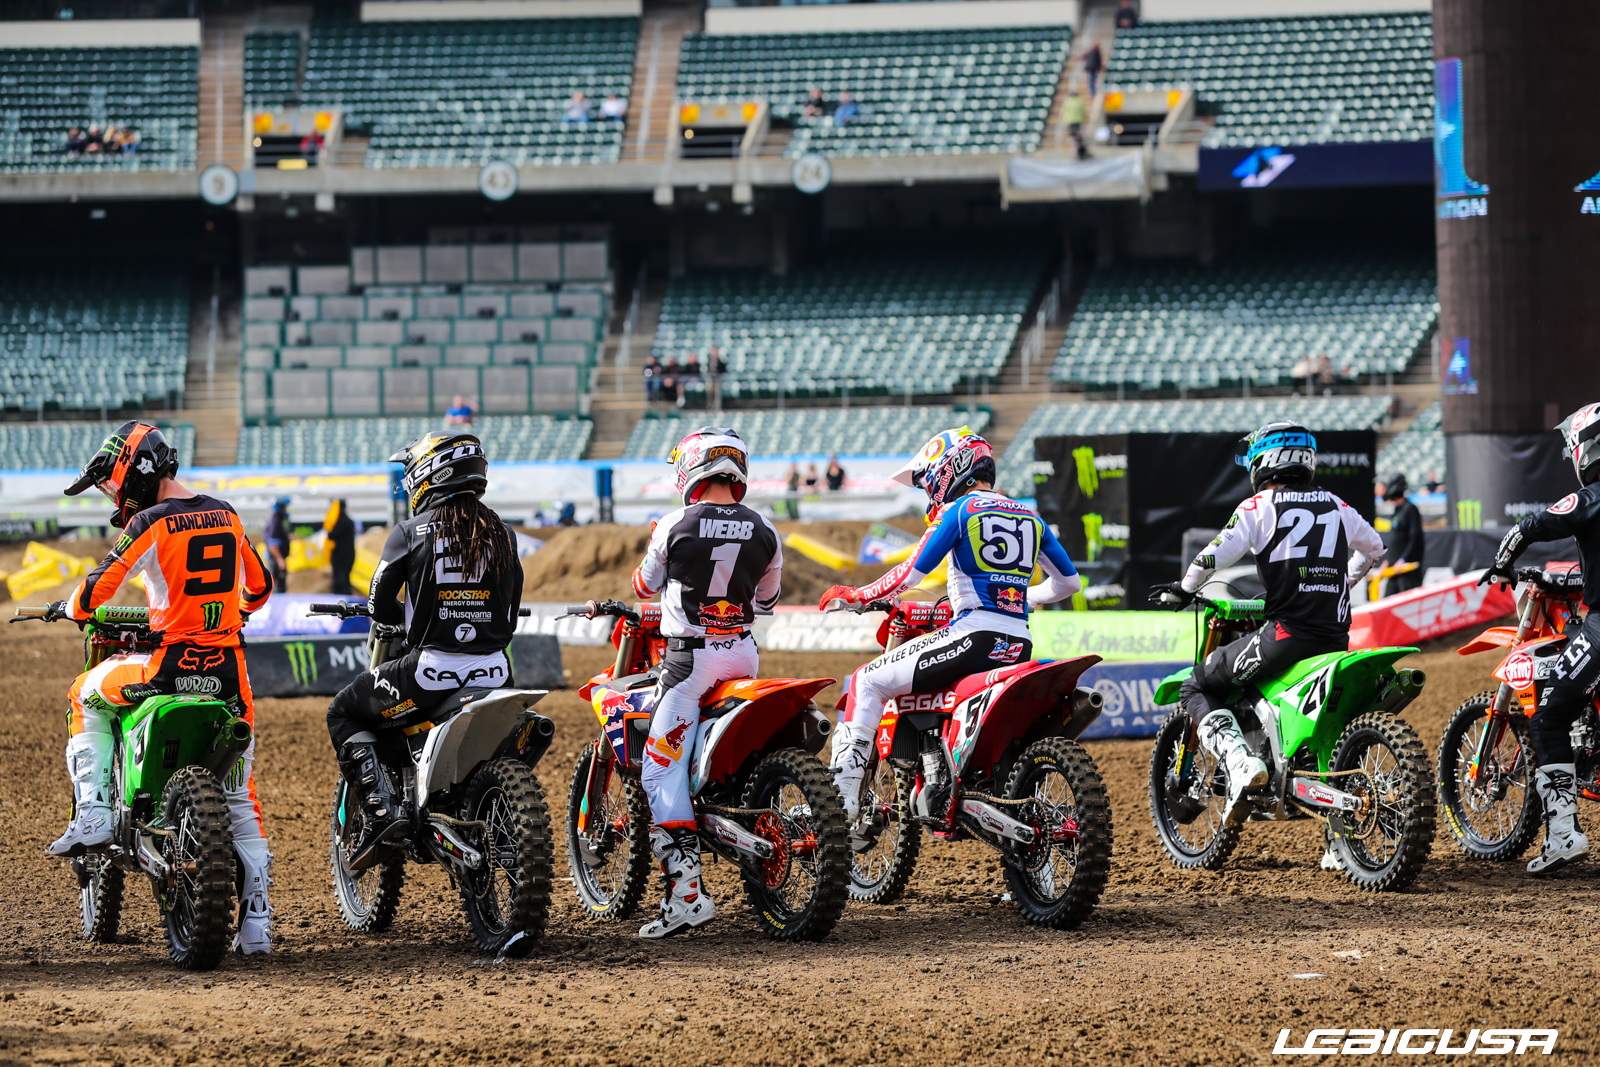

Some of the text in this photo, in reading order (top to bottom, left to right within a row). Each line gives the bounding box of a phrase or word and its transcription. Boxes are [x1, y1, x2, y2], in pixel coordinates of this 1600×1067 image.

[1254, 436, 1302, 450] SCOTT
[434, 470, 451, 483] SHOEI
[1274, 491, 1331, 503] ANDERSON
[165, 511, 232, 534] CIANCIARULO
[699, 518, 754, 540] WEBB
[981, 515, 1035, 569] 51
[1269, 508, 1341, 563] 21
[184, 532, 236, 596] 9
[707, 542, 742, 597] 1
[863, 582, 884, 600] TROY
[882, 572, 897, 590] LEE
[896, 534, 927, 579] DESIGNS
[989, 573, 1029, 586] GASGAS
[1298, 583, 1339, 593] Kawasaki
[438, 590, 490, 600] ROCKSTAR
[1391, 583, 1490, 631] FLY
[448, 610, 492, 619] Husqvarna
[864, 627, 950, 674] TROY LEE DESIGNS
[918, 637, 974, 670] GASGAS
[1553, 632, 1592, 681] FLY
[381, 698, 416, 718] ROCKSTAR
[883, 691, 957, 716] ASGAS
